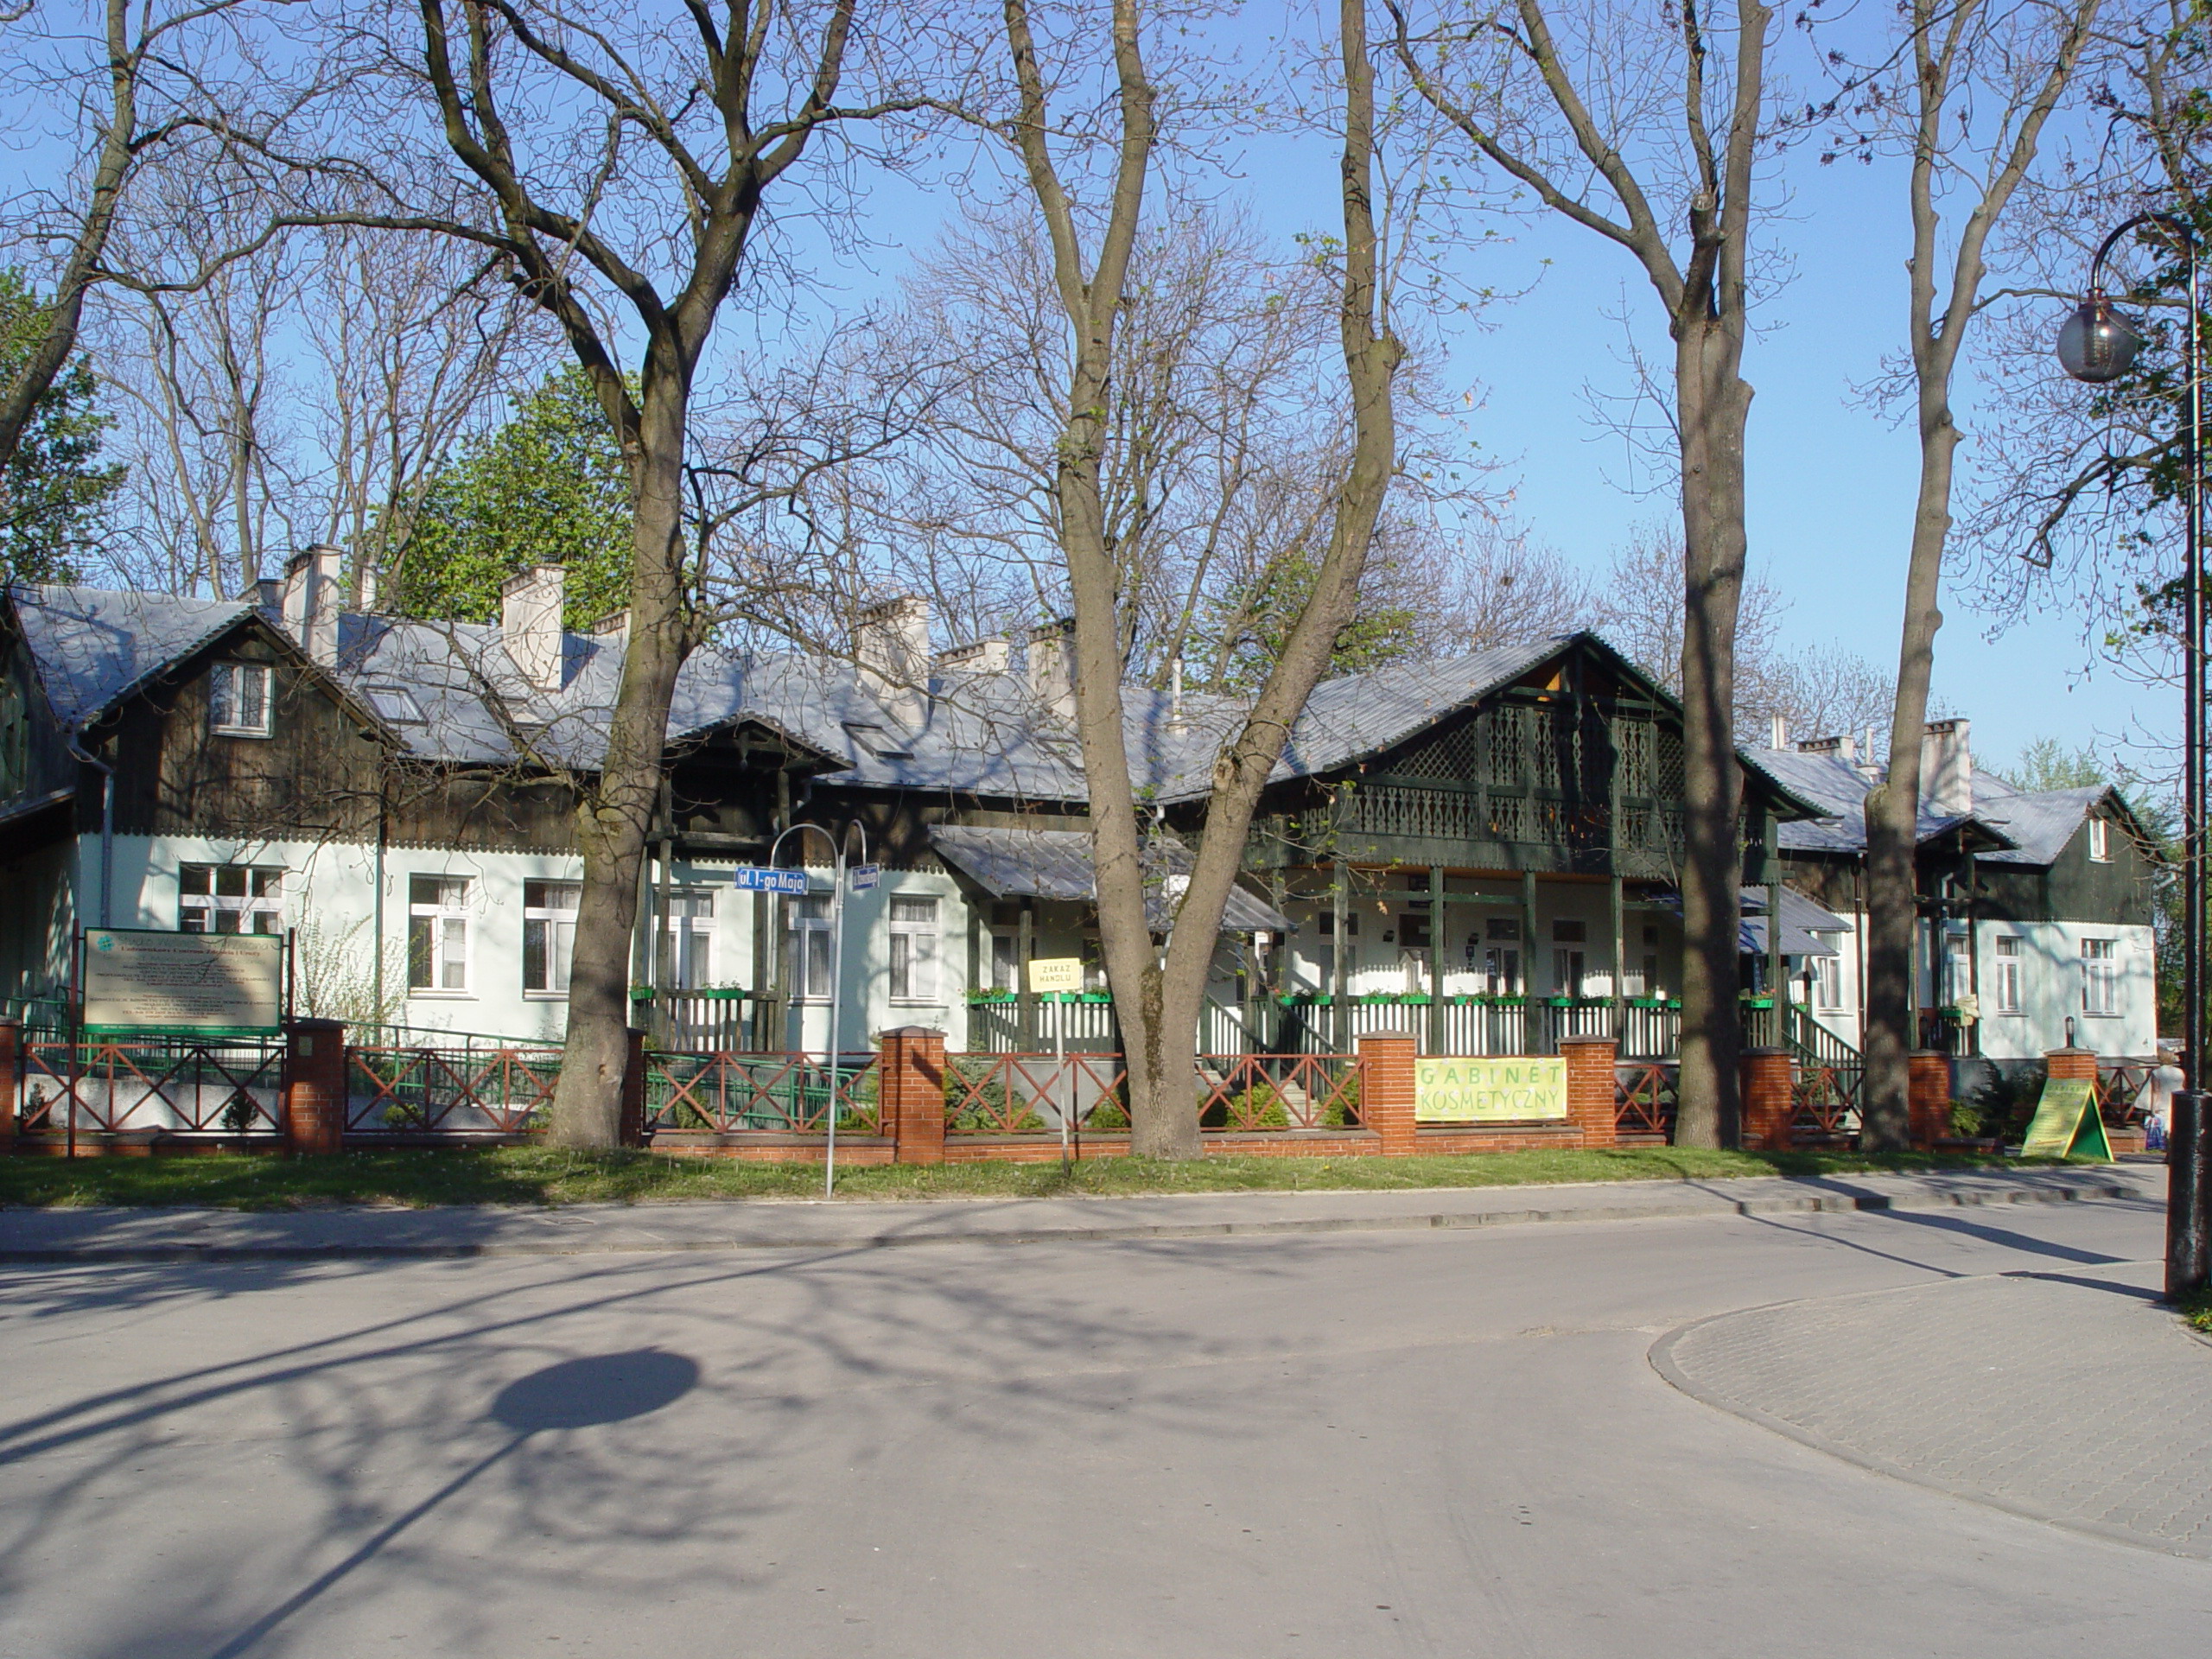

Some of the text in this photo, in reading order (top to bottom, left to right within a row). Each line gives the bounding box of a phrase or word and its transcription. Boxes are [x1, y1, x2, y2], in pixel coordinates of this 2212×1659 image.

[740, 871, 803, 893] ul. 1-go Maja
[1043, 964, 1071, 973] ZAKAZ
[1421, 1066, 1560, 1084] GABINET
[1421, 1090, 1559, 1110] KOSMETYCZNY
